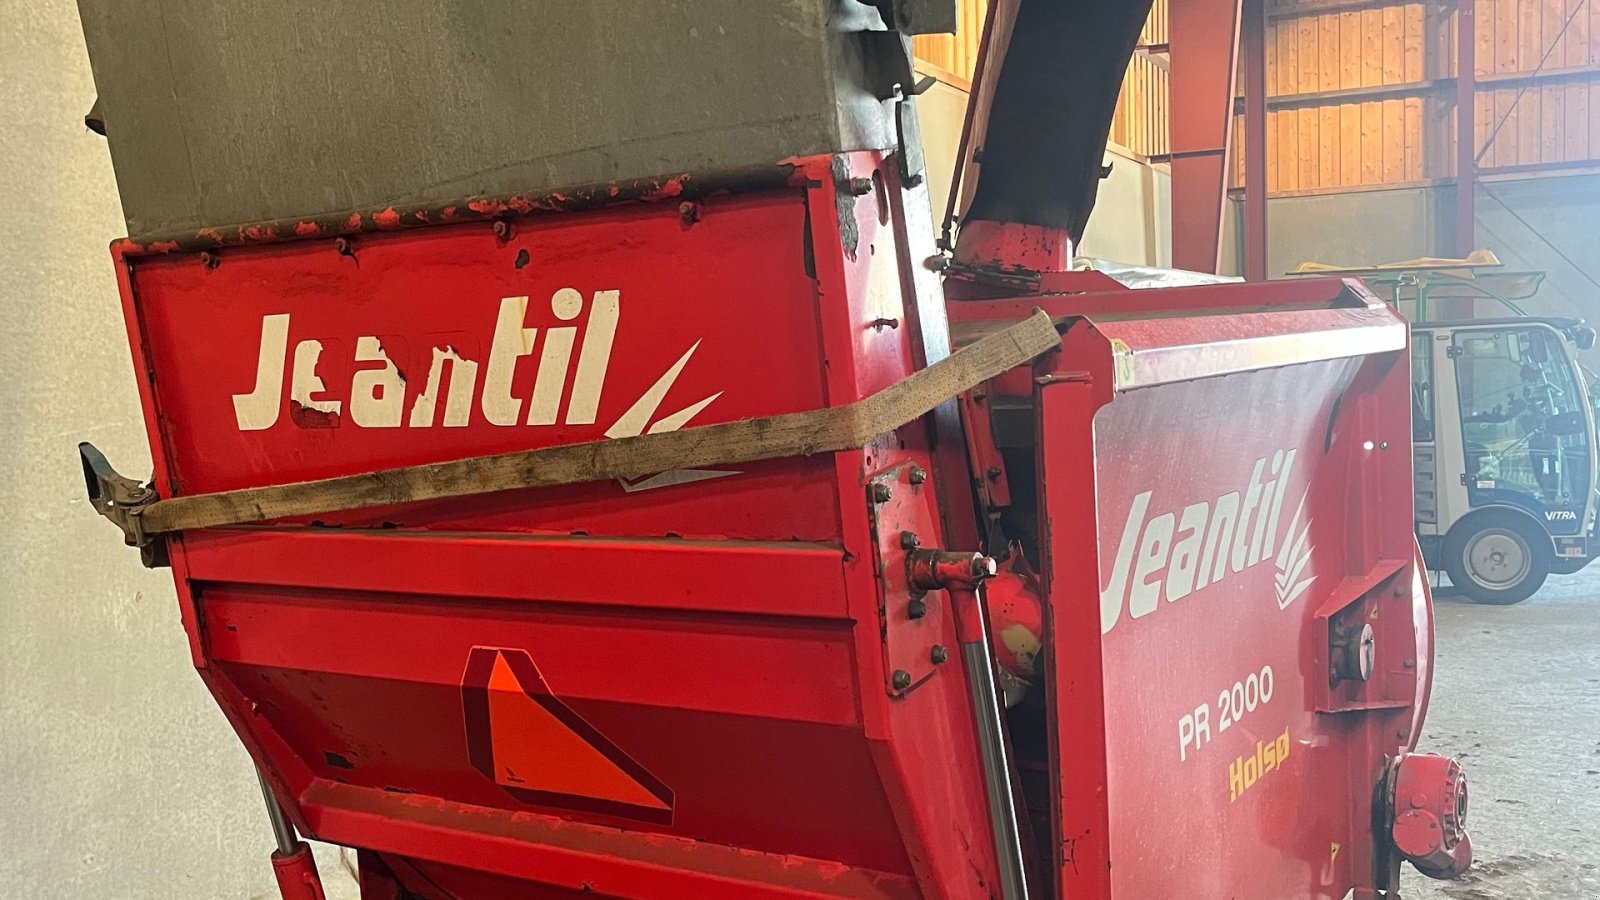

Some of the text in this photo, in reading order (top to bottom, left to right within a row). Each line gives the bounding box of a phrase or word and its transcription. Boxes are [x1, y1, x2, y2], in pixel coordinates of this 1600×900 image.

[1101, 448, 1296, 635] Jeantil
[1544, 511, 1577, 521] VITRA
[1178, 665, 1274, 762] PR 2000
[1228, 726, 1290, 804] Holsø
